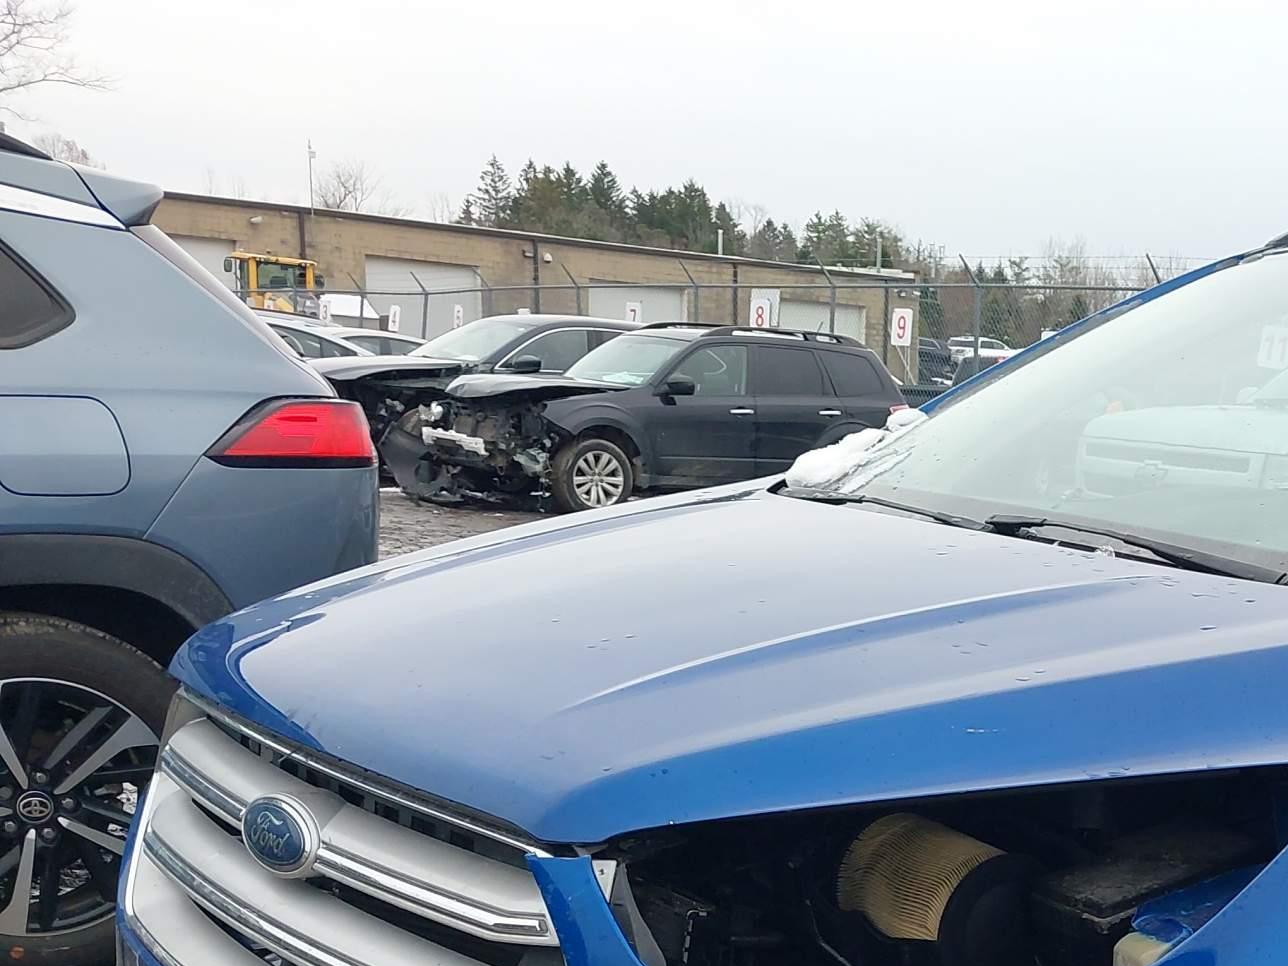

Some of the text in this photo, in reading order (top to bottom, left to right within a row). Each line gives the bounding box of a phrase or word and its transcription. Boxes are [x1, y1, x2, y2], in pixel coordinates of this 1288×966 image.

[322, 304, 328, 320] 3
[629, 308, 637, 322] 7
[756, 305, 764, 327] 8
[897, 315, 906, 339] 9
[250, 811, 290, 854] Ford
